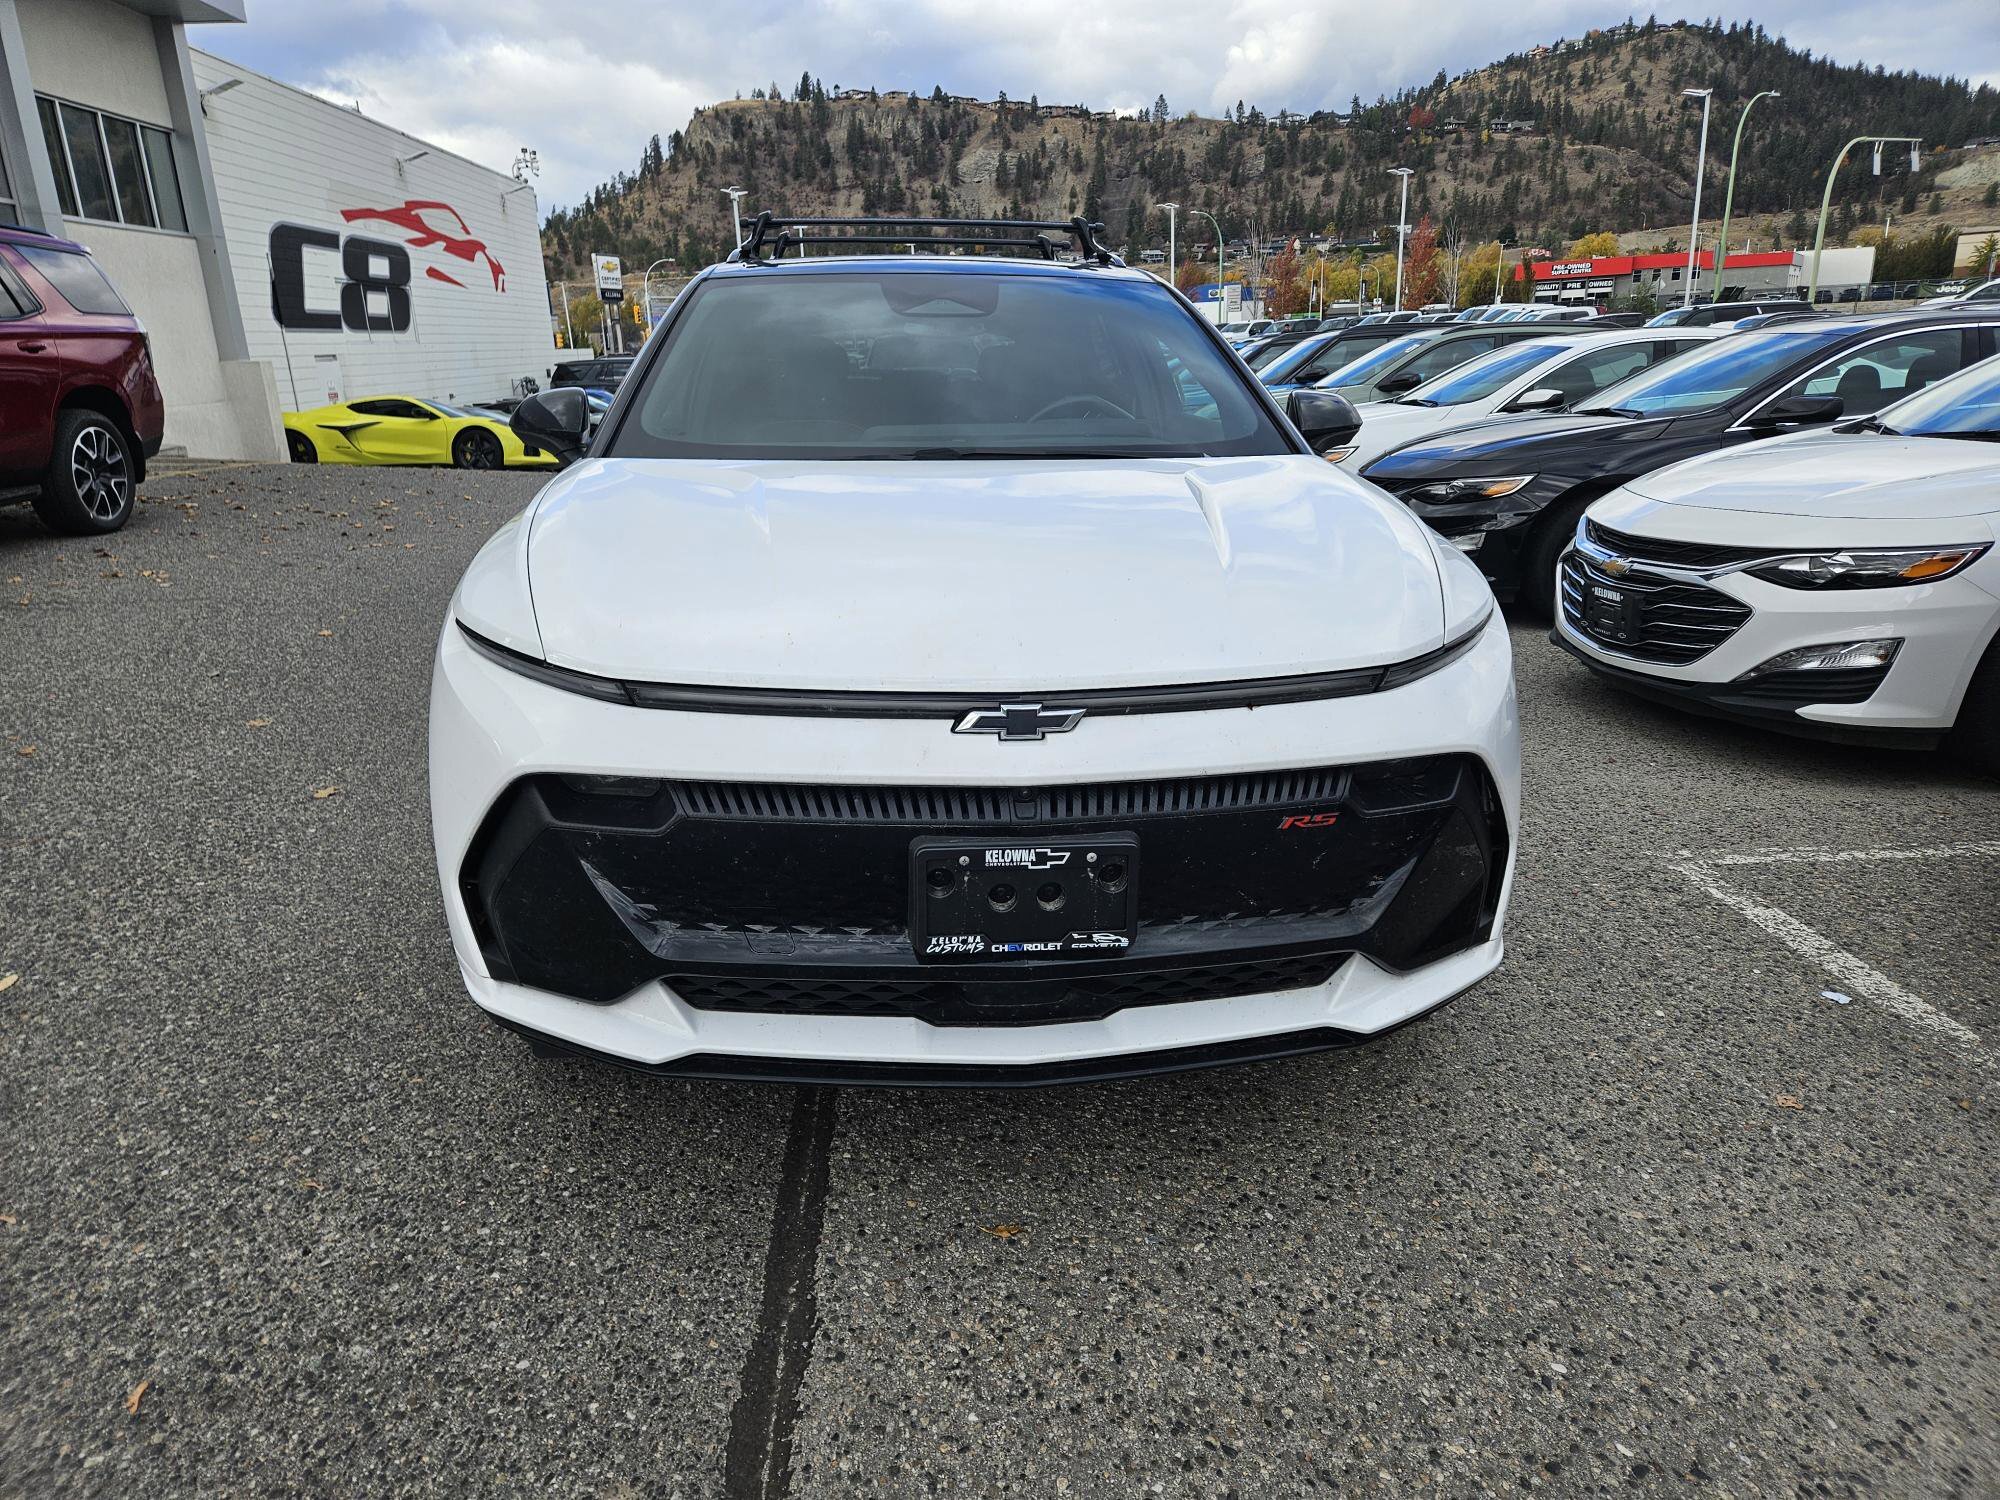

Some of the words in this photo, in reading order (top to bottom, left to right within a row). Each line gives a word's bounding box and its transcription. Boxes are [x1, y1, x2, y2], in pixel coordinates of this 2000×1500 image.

[1553, 263, 1591, 271] PRE-OWNED
[269, 220, 411, 333] C8
[1588, 280, 1613, 288] OWNED
[1936, 284, 1966, 294] Jeep
[1276, 812, 1341, 830] RS
[985, 849, 1036, 862] KELOWNA
[926, 942, 985, 954] CUSTOMS
[991, 943, 1063, 952] CHEVROLET
[1071, 941, 1129, 949] CORVETTE
